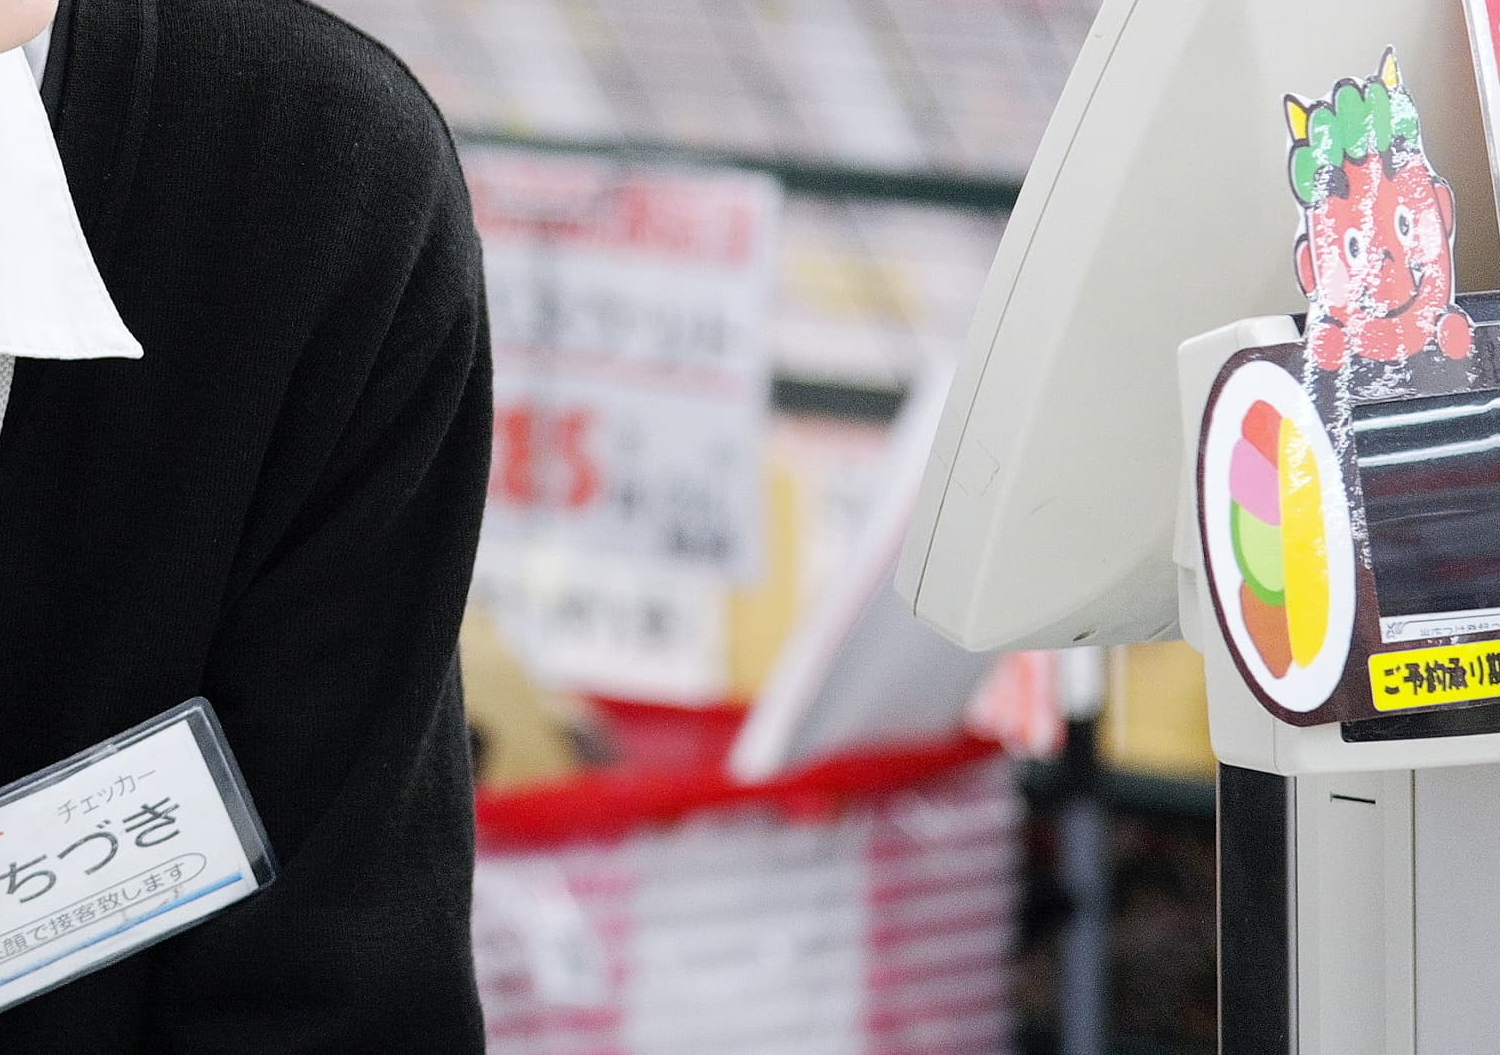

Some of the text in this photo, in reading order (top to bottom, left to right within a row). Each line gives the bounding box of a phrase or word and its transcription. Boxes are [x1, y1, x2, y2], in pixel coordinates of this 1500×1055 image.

[57, 770, 156, 824] チェッカー
